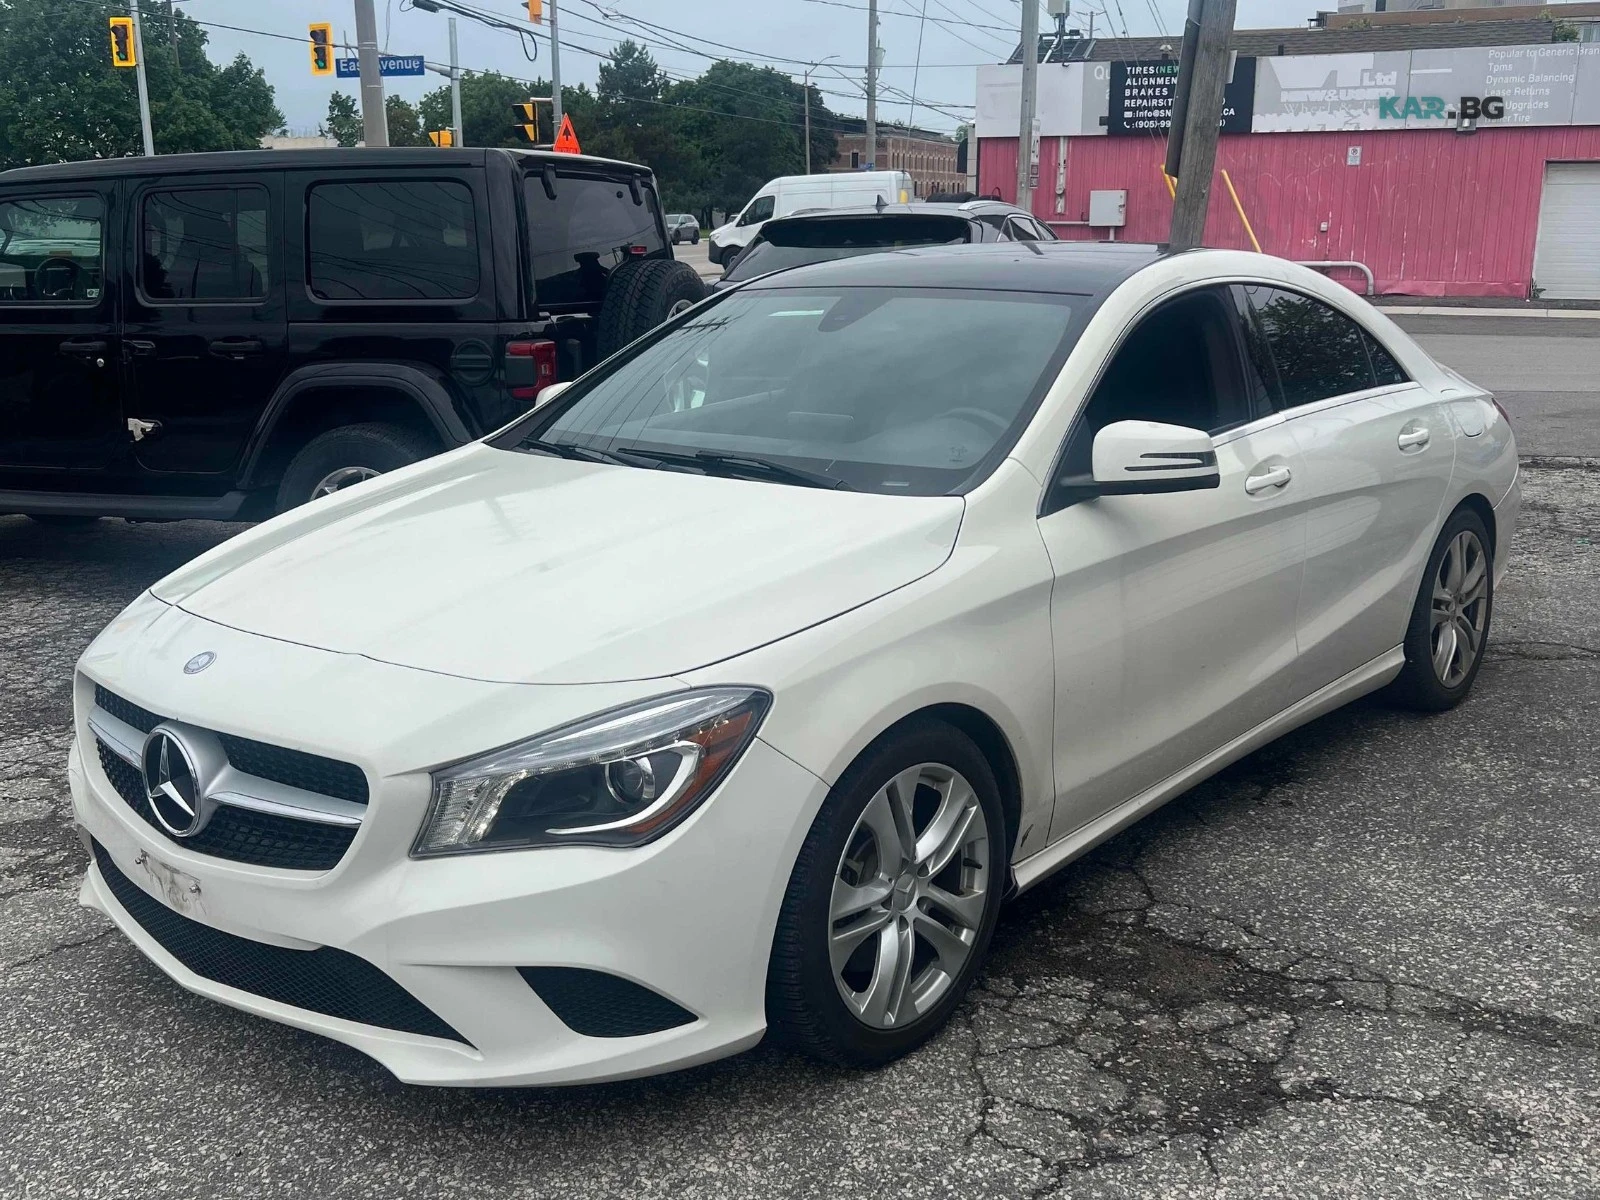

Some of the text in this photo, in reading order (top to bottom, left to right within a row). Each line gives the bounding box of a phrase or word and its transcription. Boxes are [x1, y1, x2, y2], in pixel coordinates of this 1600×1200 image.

[1488, 49, 1524, 60] Popular
[1538, 47, 1574, 57] Generic
[379, 59, 420, 71] venue
[1125, 76, 1178, 86] ALIGNMEN
[1486, 72, 1575, 86] Dynamic Balancing
[1124, 87, 1169, 97] BRAKES
[1484, 87, 1551, 98] Lease Returns
[1505, 100, 1549, 111] Upgrades
